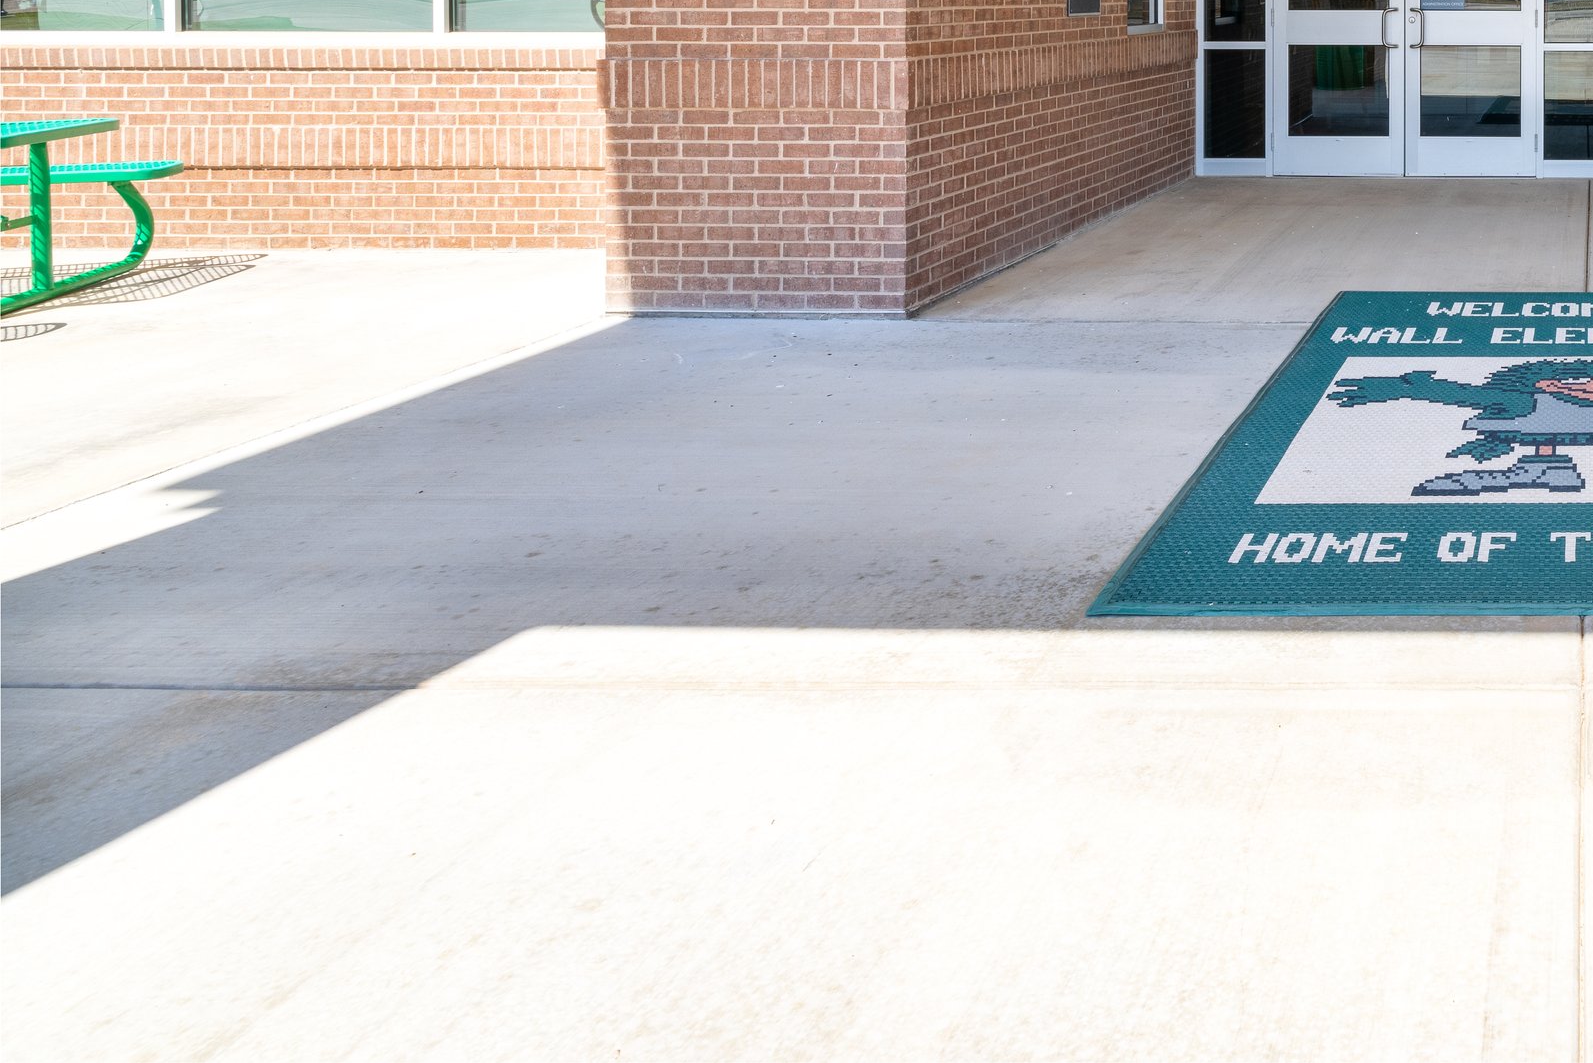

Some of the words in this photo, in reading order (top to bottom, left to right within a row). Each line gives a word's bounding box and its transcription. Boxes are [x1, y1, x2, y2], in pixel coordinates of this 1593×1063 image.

[1330, 326, 1463, 344] WALL
[1227, 532, 1409, 564] HOME
[1436, 531, 1517, 563] OF
